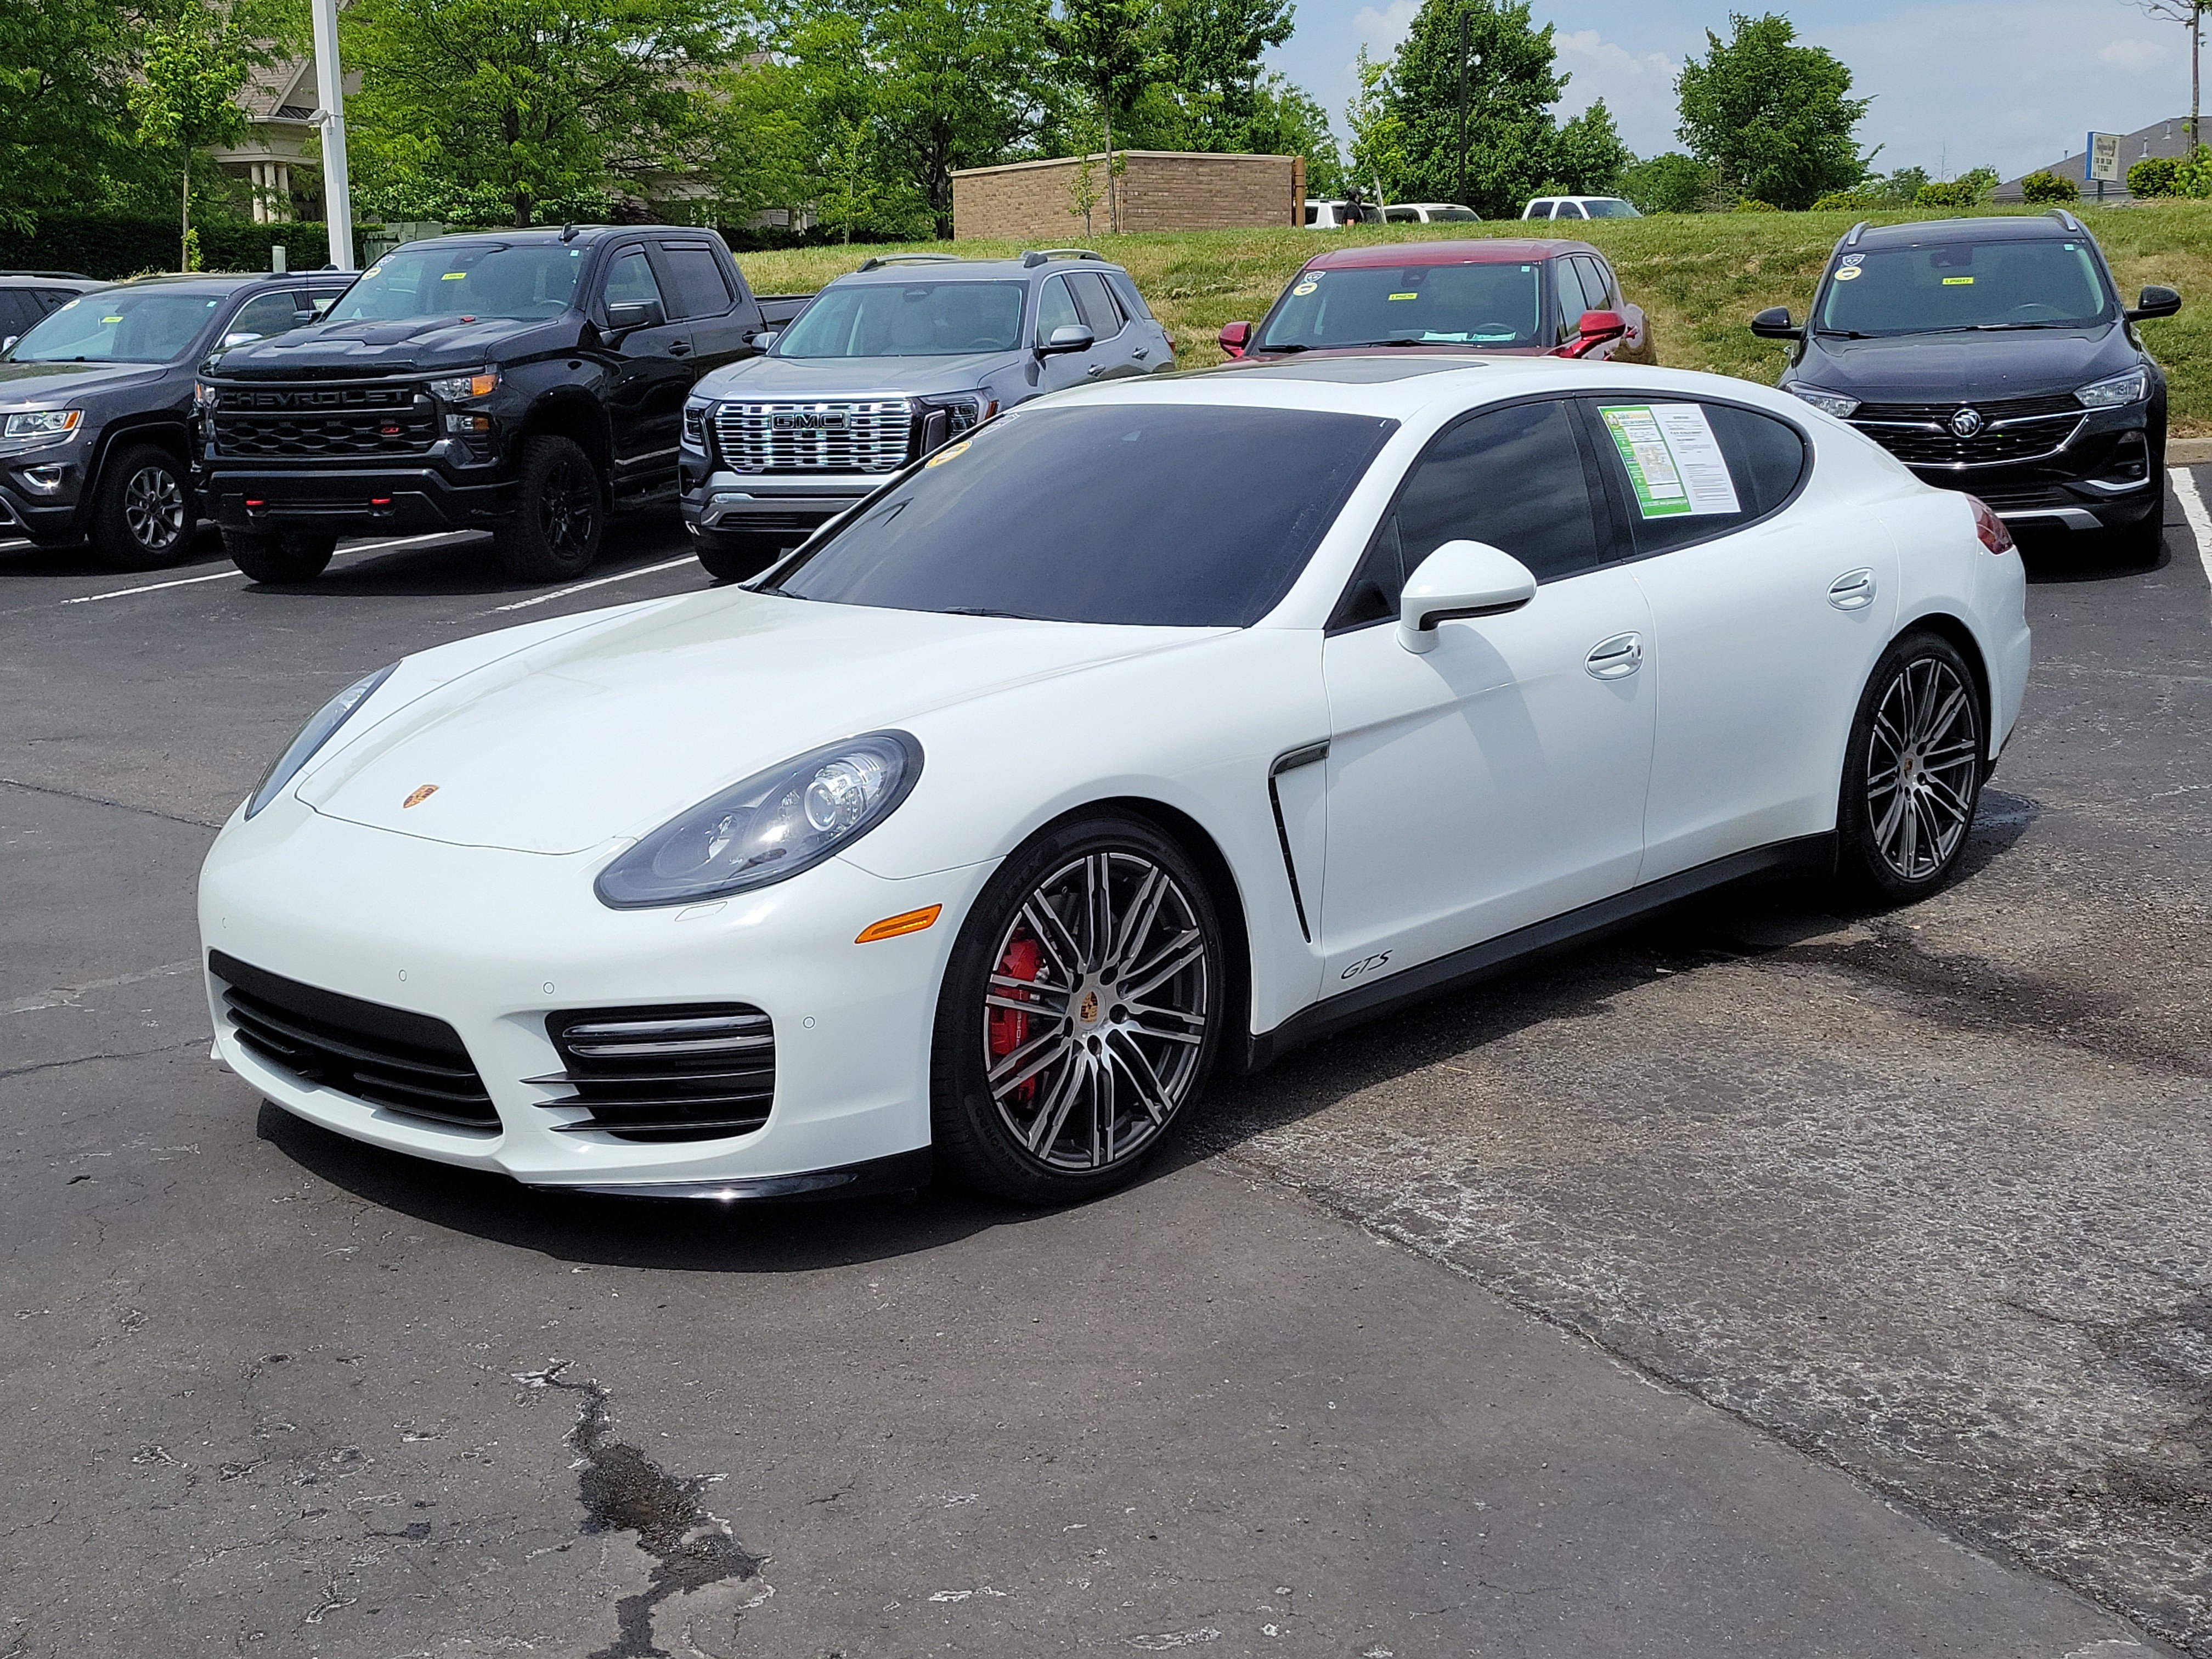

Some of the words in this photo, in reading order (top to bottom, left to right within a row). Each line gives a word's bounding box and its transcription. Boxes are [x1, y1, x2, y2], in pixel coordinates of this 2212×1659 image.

[220, 388, 409, 406] CHEVROLET
[773, 413, 844, 430] GMC
[1341, 949, 1394, 979] GTS
